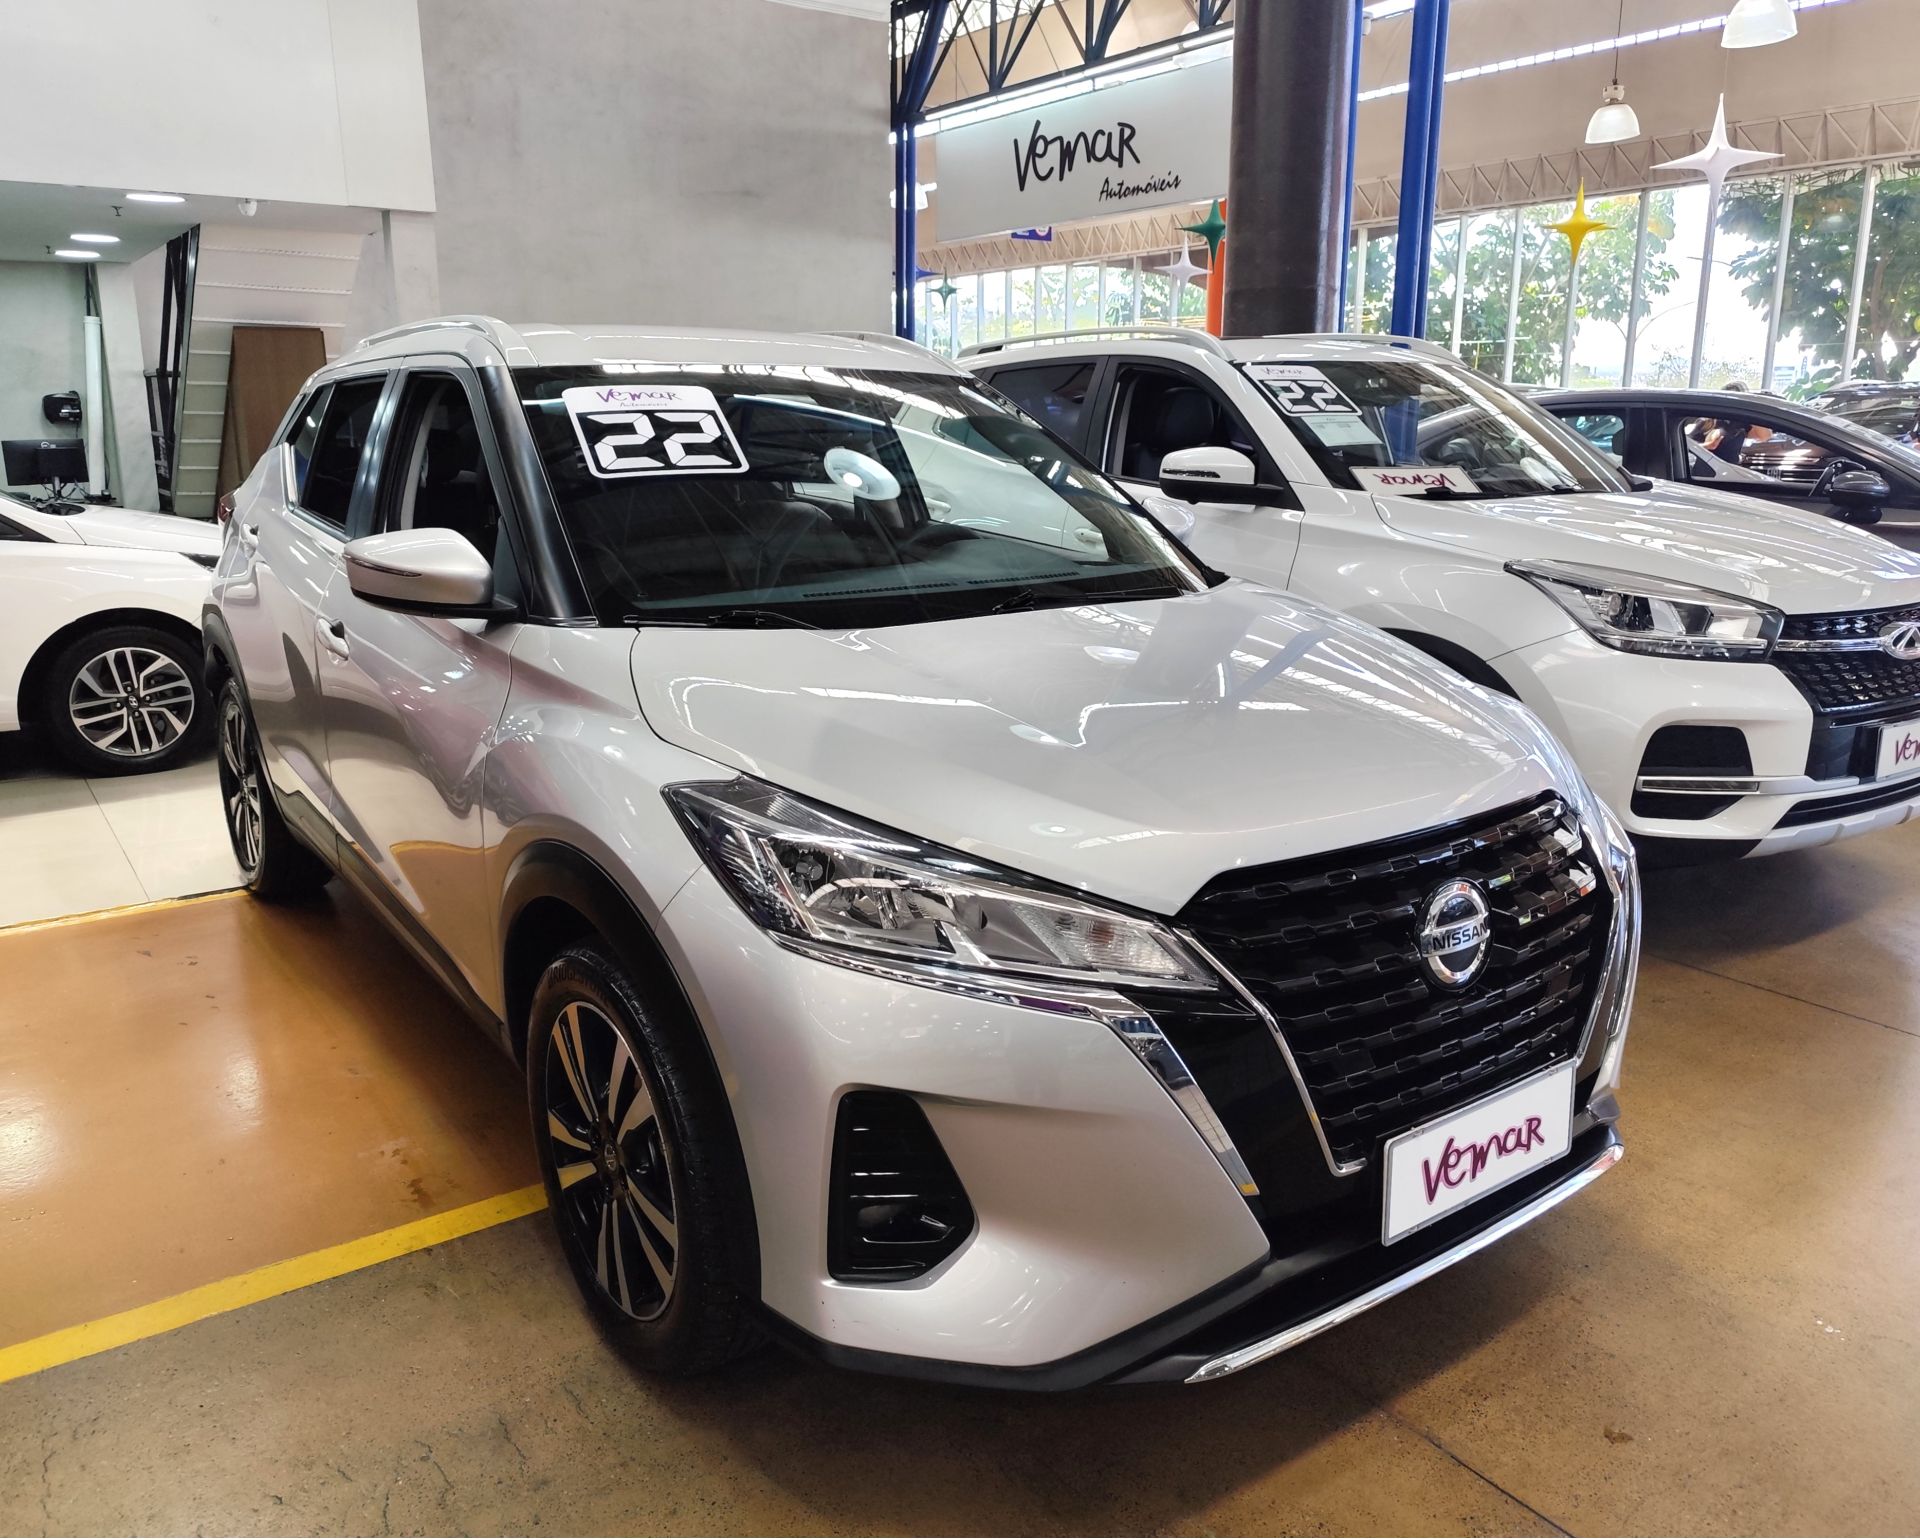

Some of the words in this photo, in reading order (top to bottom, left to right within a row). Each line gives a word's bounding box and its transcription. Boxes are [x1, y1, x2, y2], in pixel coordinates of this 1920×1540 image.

[1098, 170, 1182, 202] Automóveis
[1263, 380, 1353, 412] 22
[586, 412, 733, 470] 22
[1432, 922, 1489, 951] NISSAN
